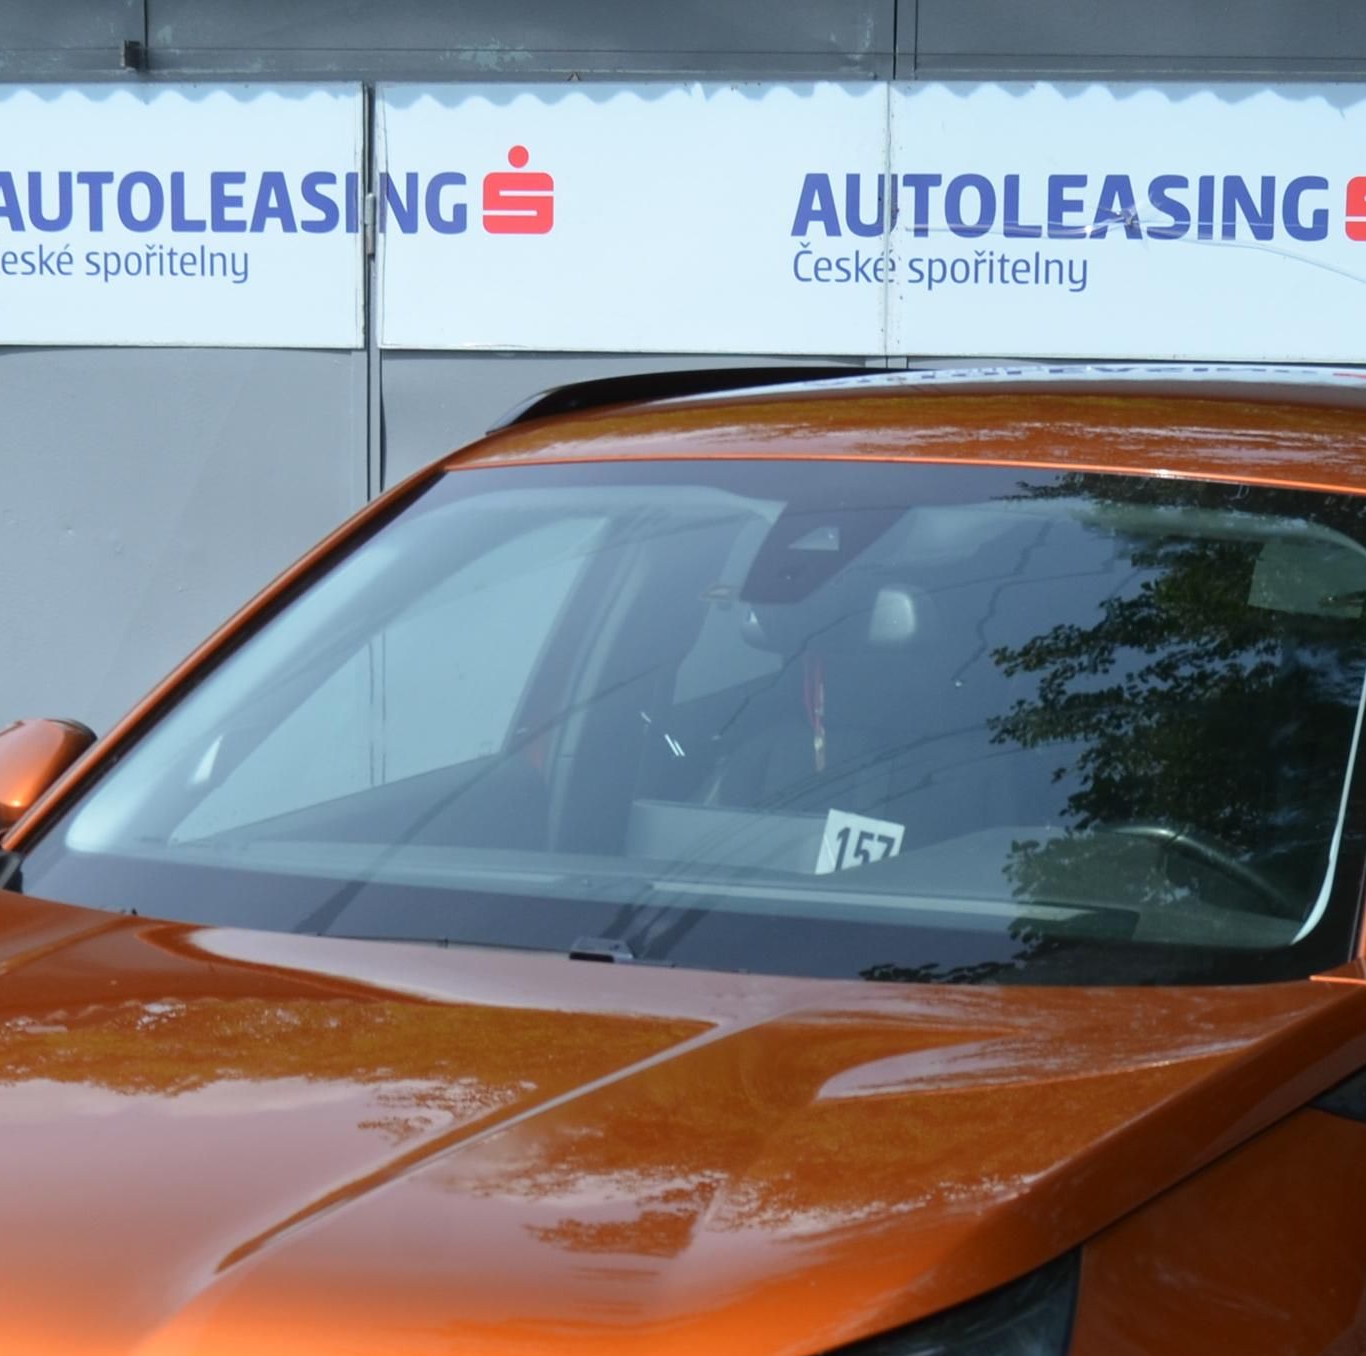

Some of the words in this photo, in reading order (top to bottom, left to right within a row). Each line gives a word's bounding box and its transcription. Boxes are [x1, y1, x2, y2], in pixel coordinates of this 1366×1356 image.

[791, 173, 1330, 243] AUTOLEASING
[86, 246, 250, 284] spořitelny
[793, 241, 897, 284] České
[907, 249, 1089, 293] spořitelny
